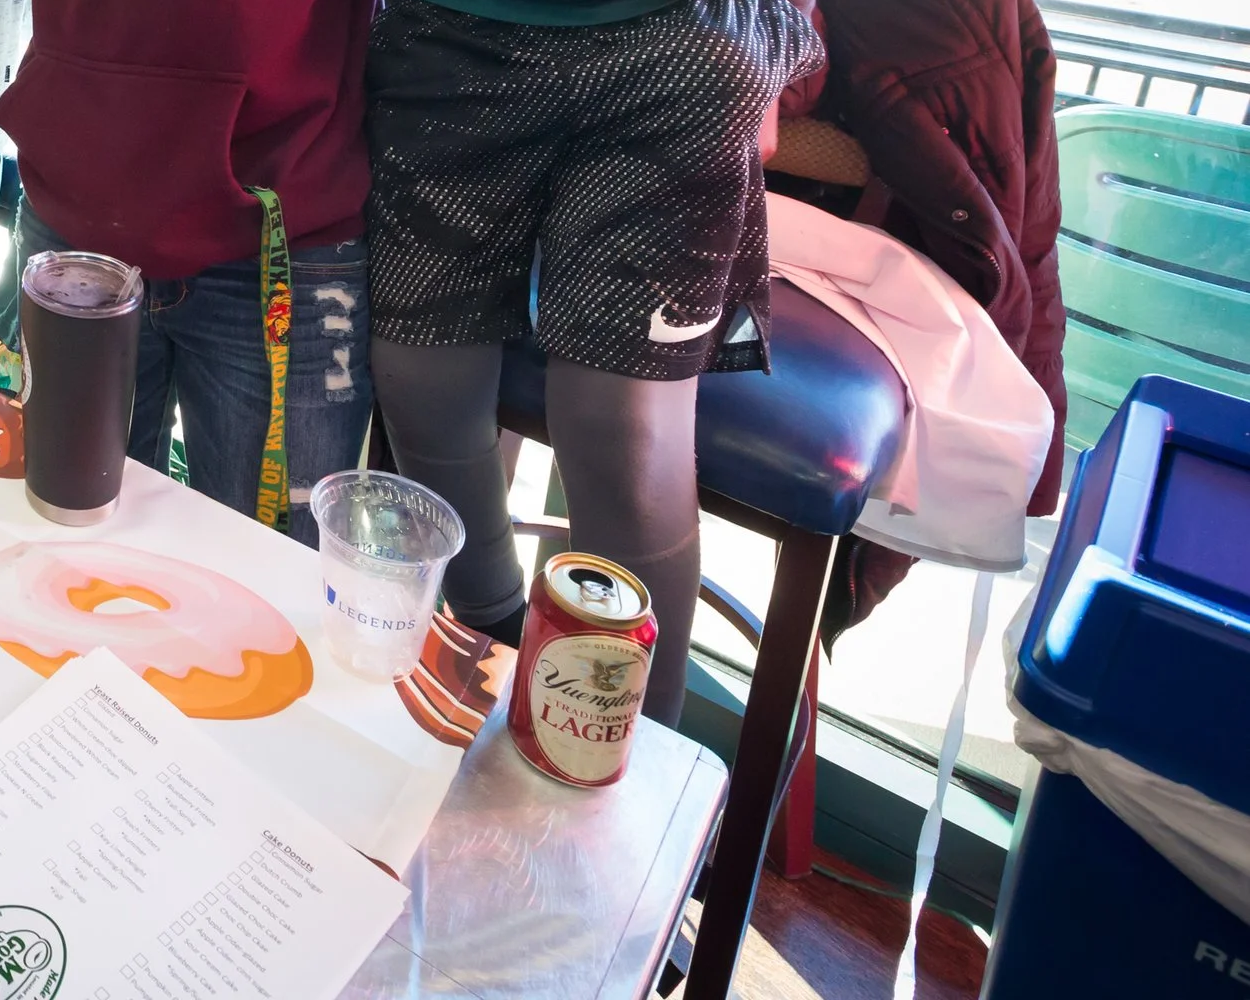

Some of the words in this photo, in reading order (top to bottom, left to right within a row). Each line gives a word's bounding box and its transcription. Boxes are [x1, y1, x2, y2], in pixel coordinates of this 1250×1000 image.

[265, 343, 287, 450] KRYPTON
[260, 457, 284, 485] OF
[258, 487, 279, 526] ON
[338, 600, 417, 631] LEGENDS
[534, 658, 645, 713] Yuengling
[82, 707, 110, 731] Cinnamon
[92, 684, 113, 702] Yeast
[110, 700, 136, 722] Raised
[132, 720, 161, 745] Donuts
[553, 700, 637, 724] TRADITIONAL
[48, 733, 69, 751] Boston
[60, 724, 88, 749] Powdered
[101, 762, 121, 780] Cream
[12, 760, 43, 788] Strawberry
[24, 751, 47, 772] Sugared
[37, 743, 52, 757] Black
[50, 755, 78, 781] Raspberry
[116, 757, 138, 776] dipped
[1, 769, 22, 789] Cookies
[26, 793, 44, 810] Cream
[166, 783, 195, 808] Blueberry
[194, 806, 218, 827] Fritters
[176, 772, 195, 789] Apple
[193, 786, 217, 807] Fritters
[143, 798, 165, 818] Cherry
[162, 815, 186, 836] Fritters
[139, 831, 161, 851] Fritters
[262, 828, 284, 848] Cake
[283, 845, 316, 873] Donuts
[51, 869, 72, 890] Ginger
[75, 850, 94, 869] Apple
[92, 866, 119, 891] Caramel
[124, 856, 148, 878] Delight
[260, 862, 281, 881] Dutch
[279, 877, 304, 899] Crumb
[271, 850, 305, 880] Cinnamon
[251, 874, 274, 895] Glazed
[272, 892, 291, 909] Cake
[203, 915, 226, 936] Apple
[219, 906, 237, 923] Choc
[235, 921, 253, 938] Chip
[224, 893, 249, 915] Glazed
[247, 912, 266, 930] Choc
[264, 928, 283, 946] Cake
[237, 883, 263, 906] Double
[261, 903, 279, 920] Choc
[278, 918, 297, 936] Cake
[195, 926, 217, 948] Apple
[143, 966, 174, 998] Pumpkin
[166, 945, 201, 979] Blueberry
[199, 976, 218, 995] Cake
[182, 937, 201, 955] Sour
[198, 952, 223, 976] Cream
[221, 973, 241, 993] Cake
[38, 969, 58, 999] Made
